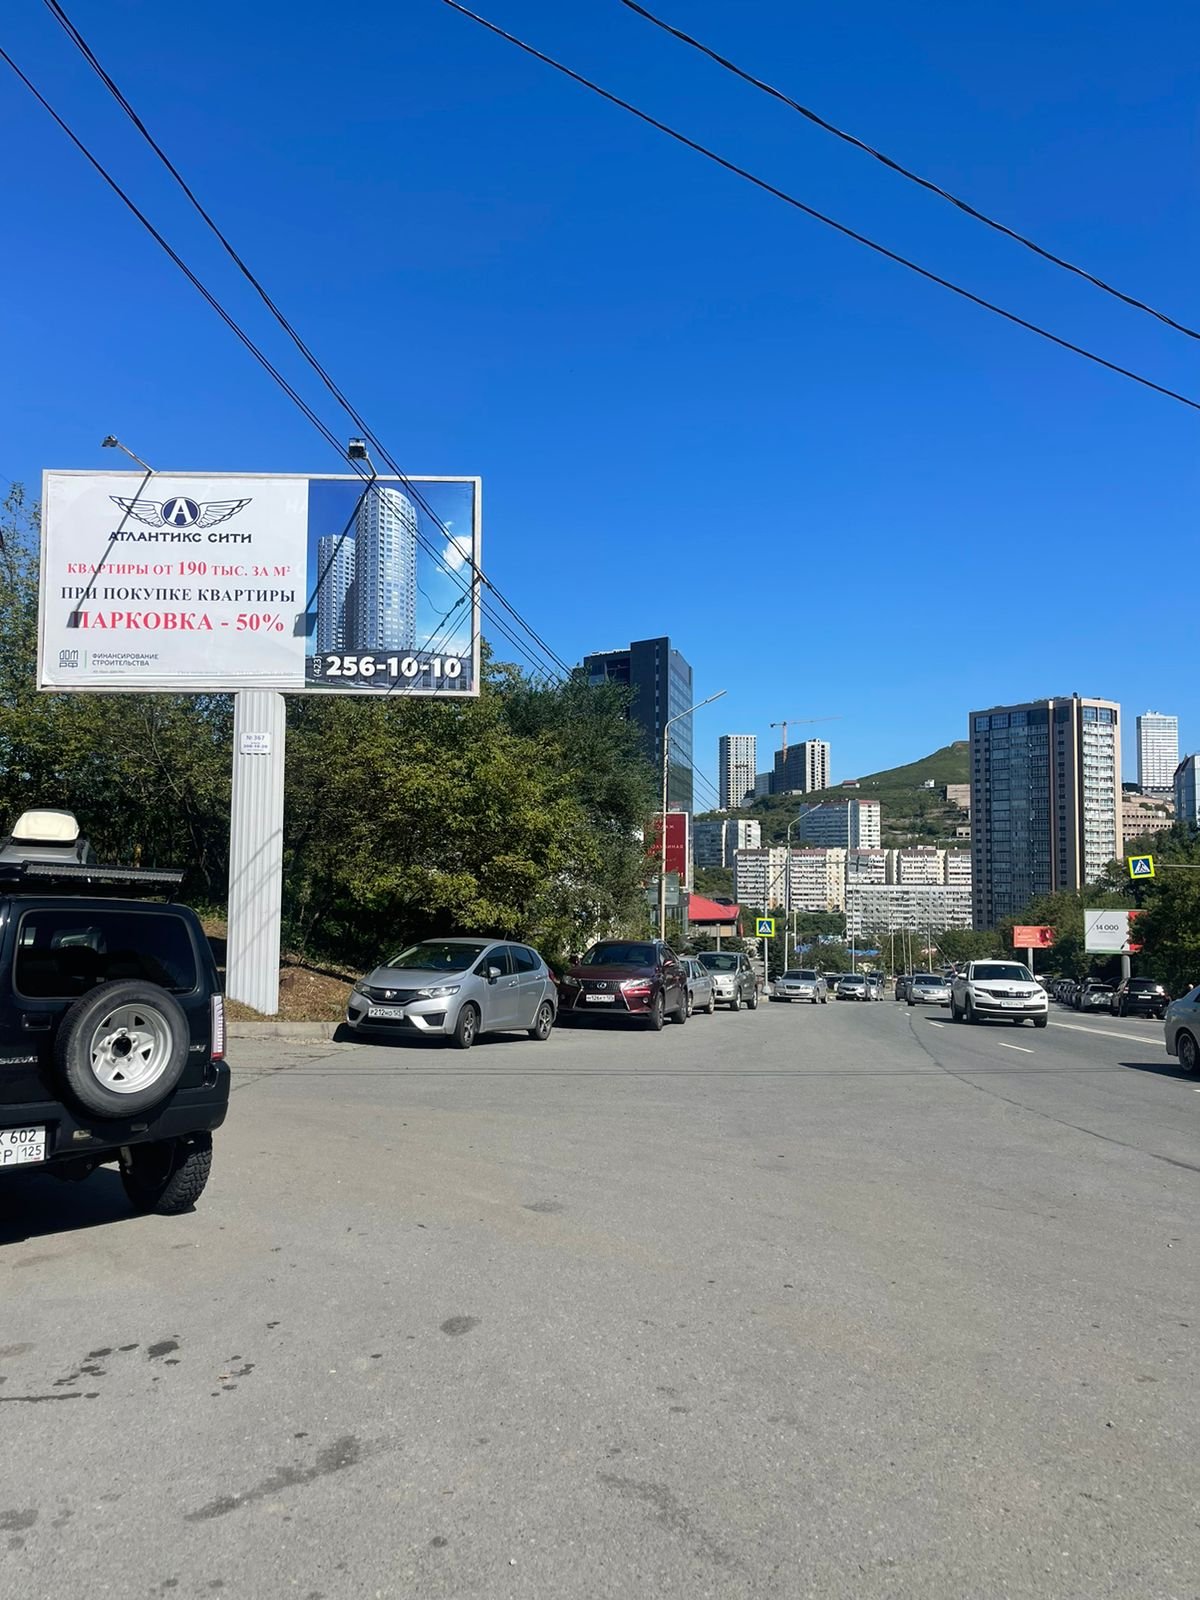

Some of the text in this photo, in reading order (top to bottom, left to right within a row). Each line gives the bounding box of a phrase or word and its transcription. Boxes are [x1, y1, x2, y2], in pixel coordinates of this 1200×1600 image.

[108, 531, 252, 543] АТЛАНТИКС СИТИ
[67, 562, 149, 575] КВАРТИРЫ
[153, 564, 174, 575] ОТ
[179, 561, 207, 576] 190
[211, 565, 248, 577] ТЫС.
[252, 566, 269, 577] ЗА
[61, 586, 295, 603] ПРИ ПОКУПКЕ КВАРТИРЫ
[72, 611, 213, 630] ПАРКОВКА
[236, 613, 284, 632] 50%
[92, 659, 149, 667] СТРОИТЕЛЬСТВА
[313, 655, 461, 678] (423) 256-10-10
[21, 1145, 42, 1157] 125
